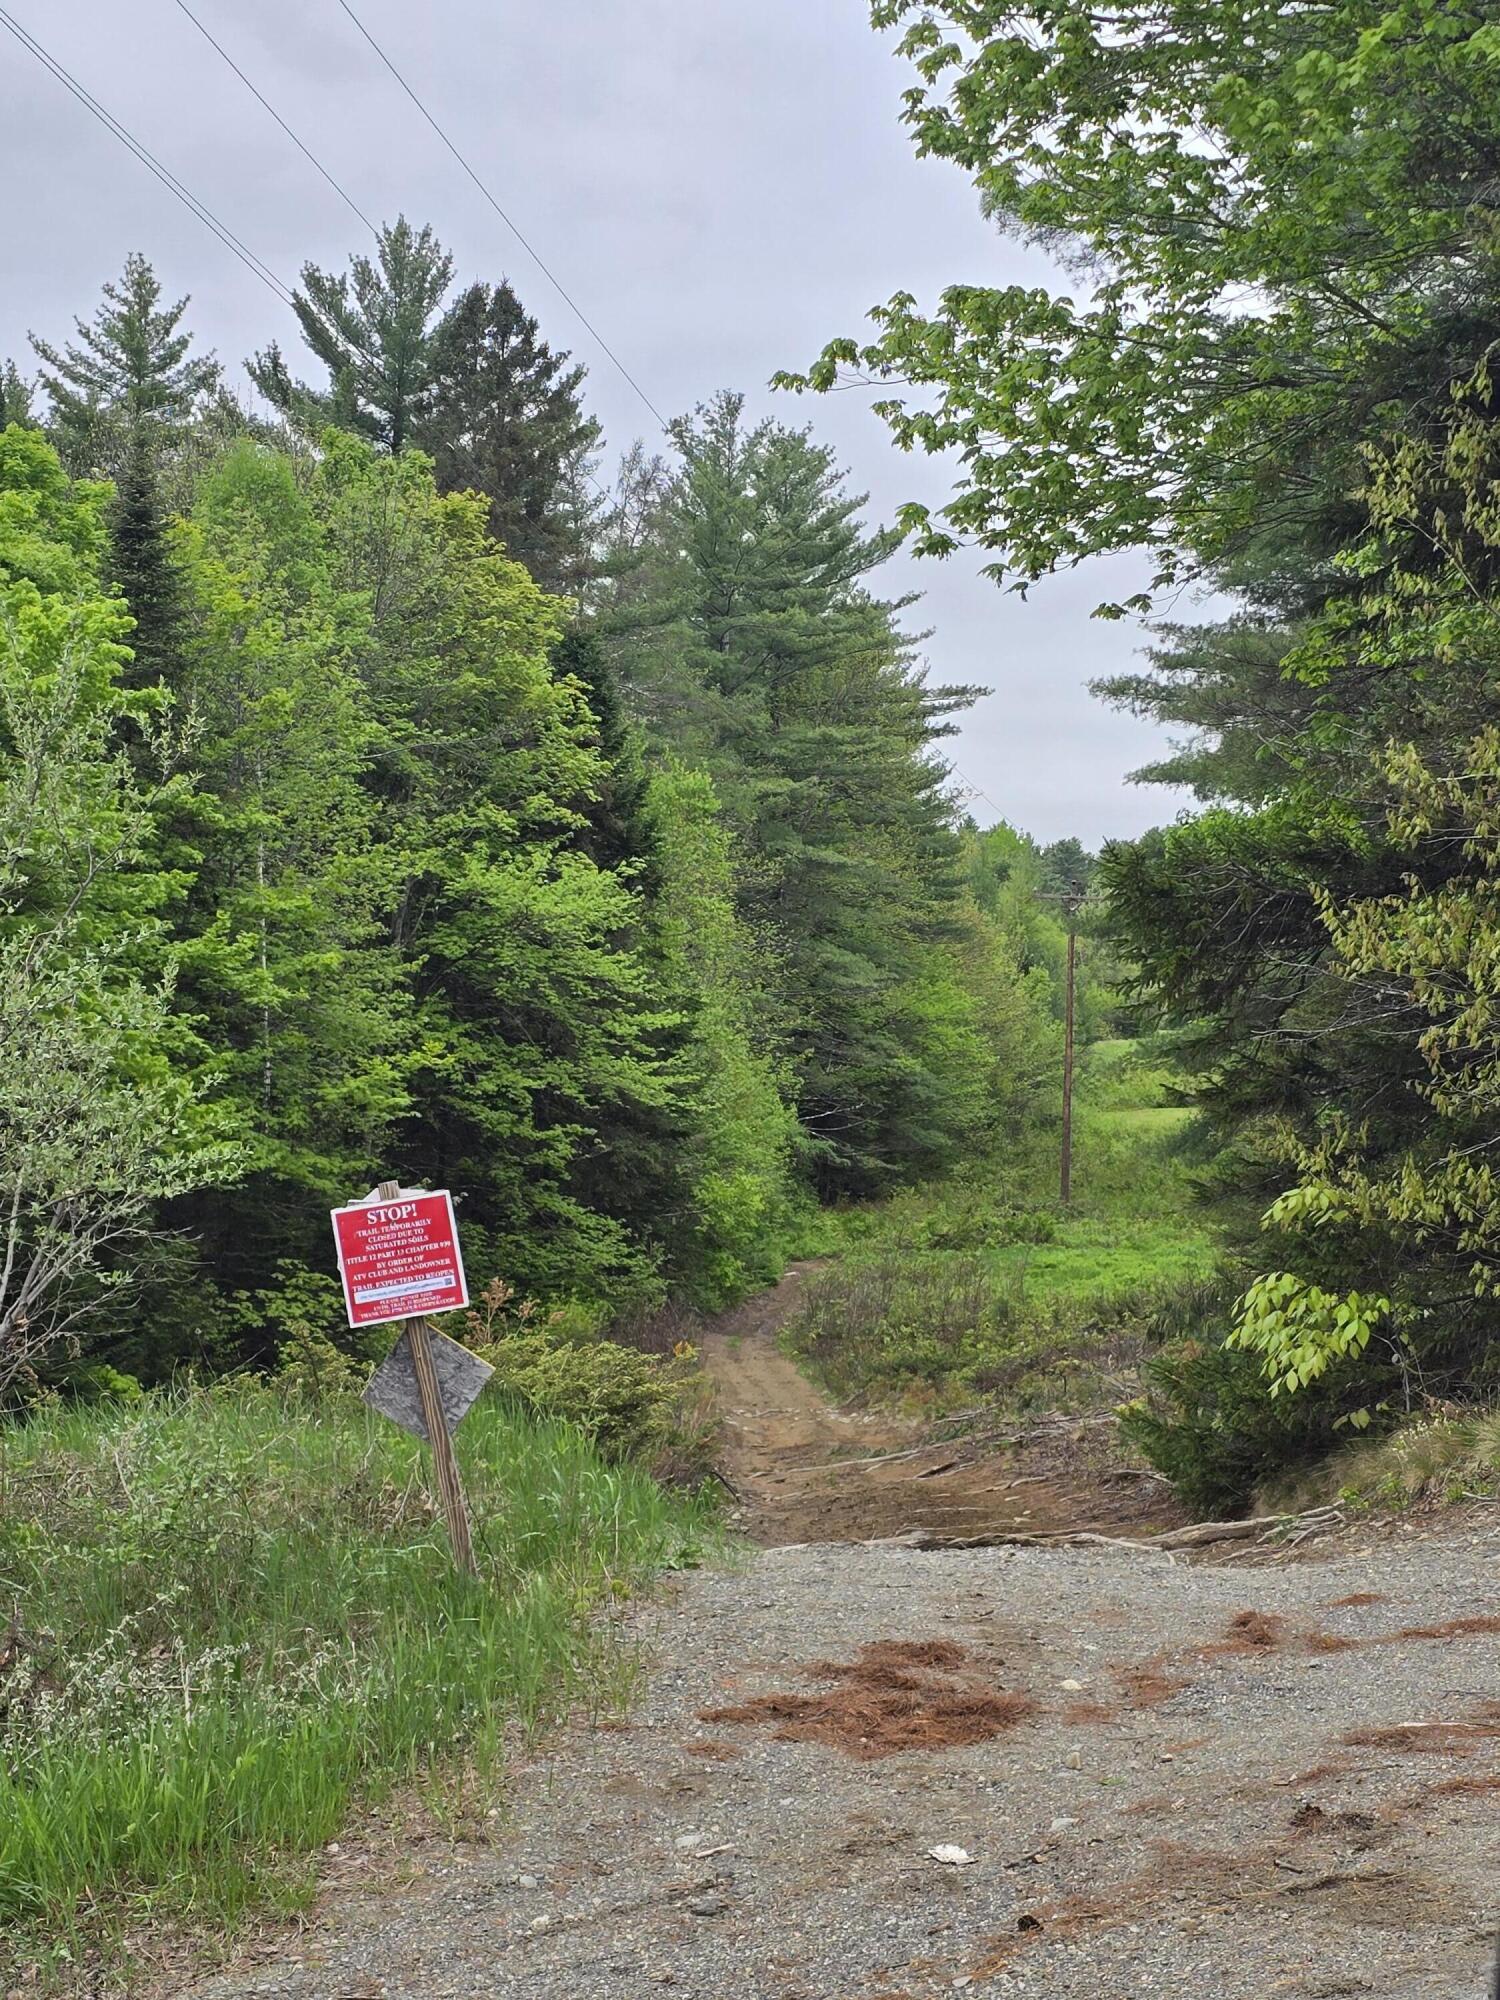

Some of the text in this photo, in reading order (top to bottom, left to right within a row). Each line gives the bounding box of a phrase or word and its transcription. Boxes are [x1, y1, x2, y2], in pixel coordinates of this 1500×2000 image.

[367, 1203, 417, 1224] STOP!
[356, 1218, 431, 1237] TRAIL TEMPORARILY
[368, 1232, 396, 1243] CLOSED
[398, 1229, 412, 1238] DUE
[366, 1235, 429, 1251] SATURATED SOILS
[346, 1255, 367, 1265] TITLE
[378, 1251, 396, 1260] PART
[405, 1242, 439, 1254] CHAPTER
[388, 1257, 413, 1266] ORDER
[414, 1254, 424, 1262] OF
[353, 1258, 451, 1281] ATV CLUB AND LANDOWNER
[353, 1284, 375, 1293] TRAIL
[376, 1276, 413, 1288] EXPECTED
